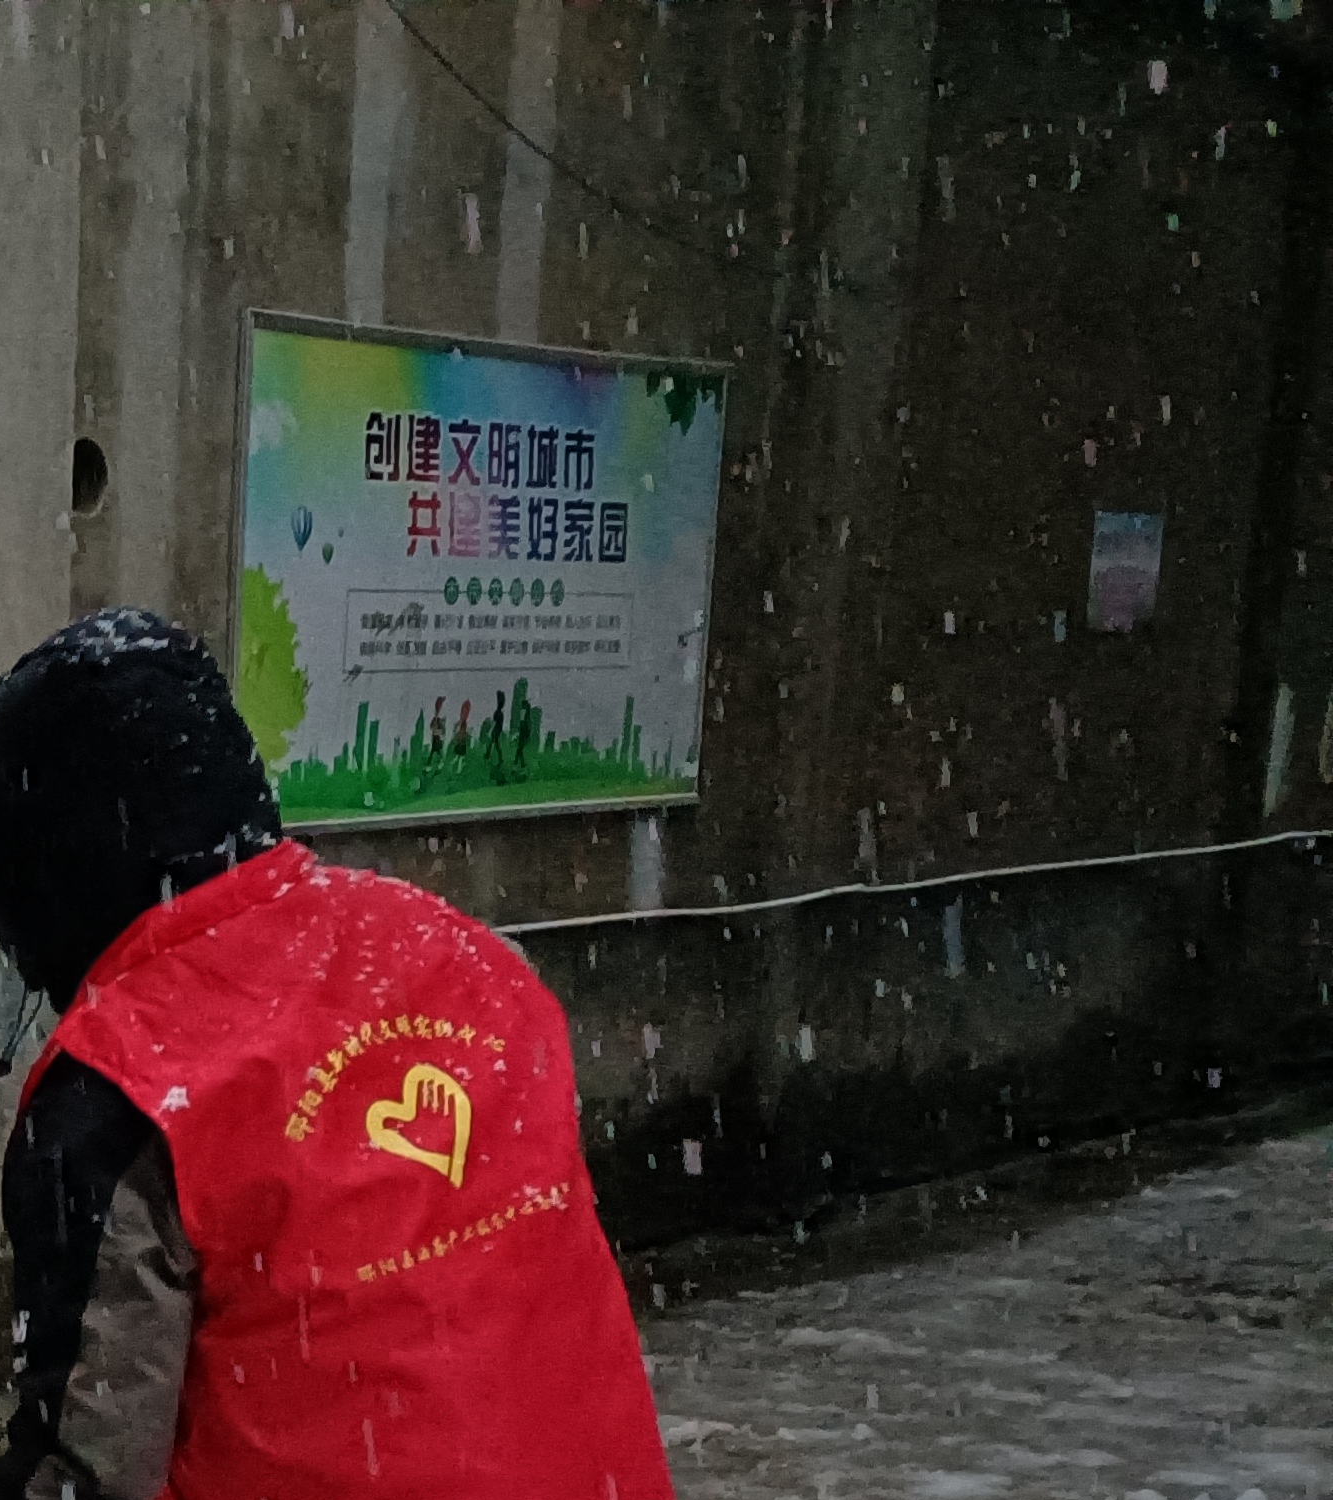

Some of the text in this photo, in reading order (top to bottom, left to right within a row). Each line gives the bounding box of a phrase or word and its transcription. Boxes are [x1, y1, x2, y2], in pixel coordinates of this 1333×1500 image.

[365, 411, 595, 490] 创建文明城市
[407, 491, 629, 563] 共建美好家园
